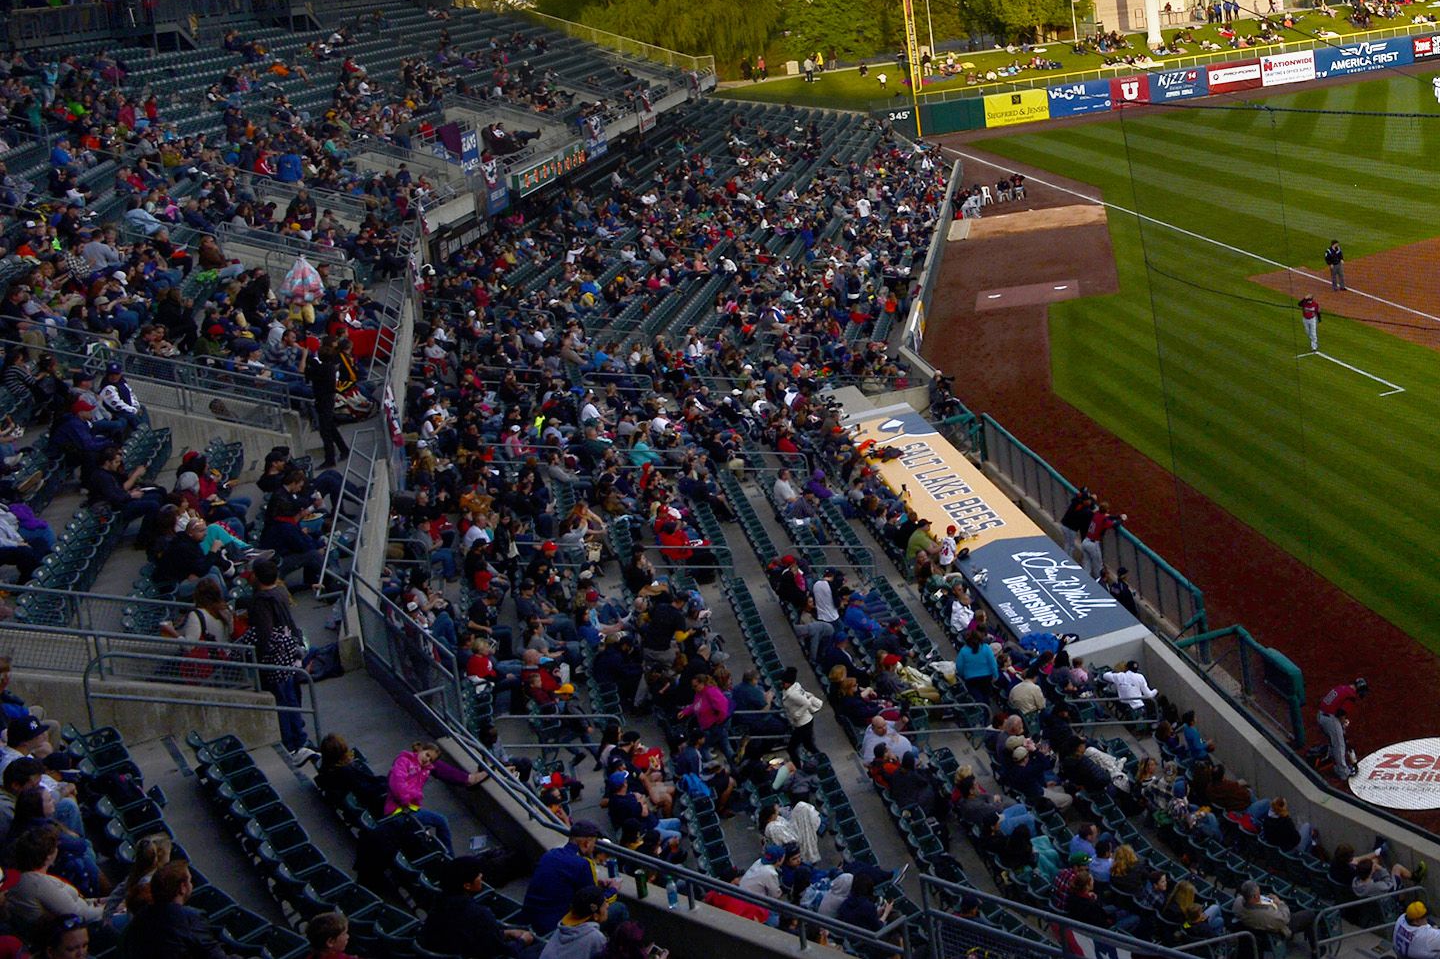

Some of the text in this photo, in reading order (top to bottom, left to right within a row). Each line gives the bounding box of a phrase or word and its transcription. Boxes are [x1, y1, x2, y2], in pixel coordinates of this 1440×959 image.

[1414, 39, 1431, 51] ZONE
[1264, 57, 1312, 71] NATIONWIDE
[1331, 55, 1372, 71] AMERICA
[1373, 51, 1399, 64] FIRST
[1188, 72, 1197, 80] 14
[1121, 82, 1139, 100] U
[889, 111, 910, 121] 345'
[987, 105, 1049, 120] SIEGFRIED & JENSEN
[898, 441, 1006, 537] SALT LAKE BEES
[1002, 575, 1063, 627] Dealerships
[998, 602, 1031, 633] Driven By You
